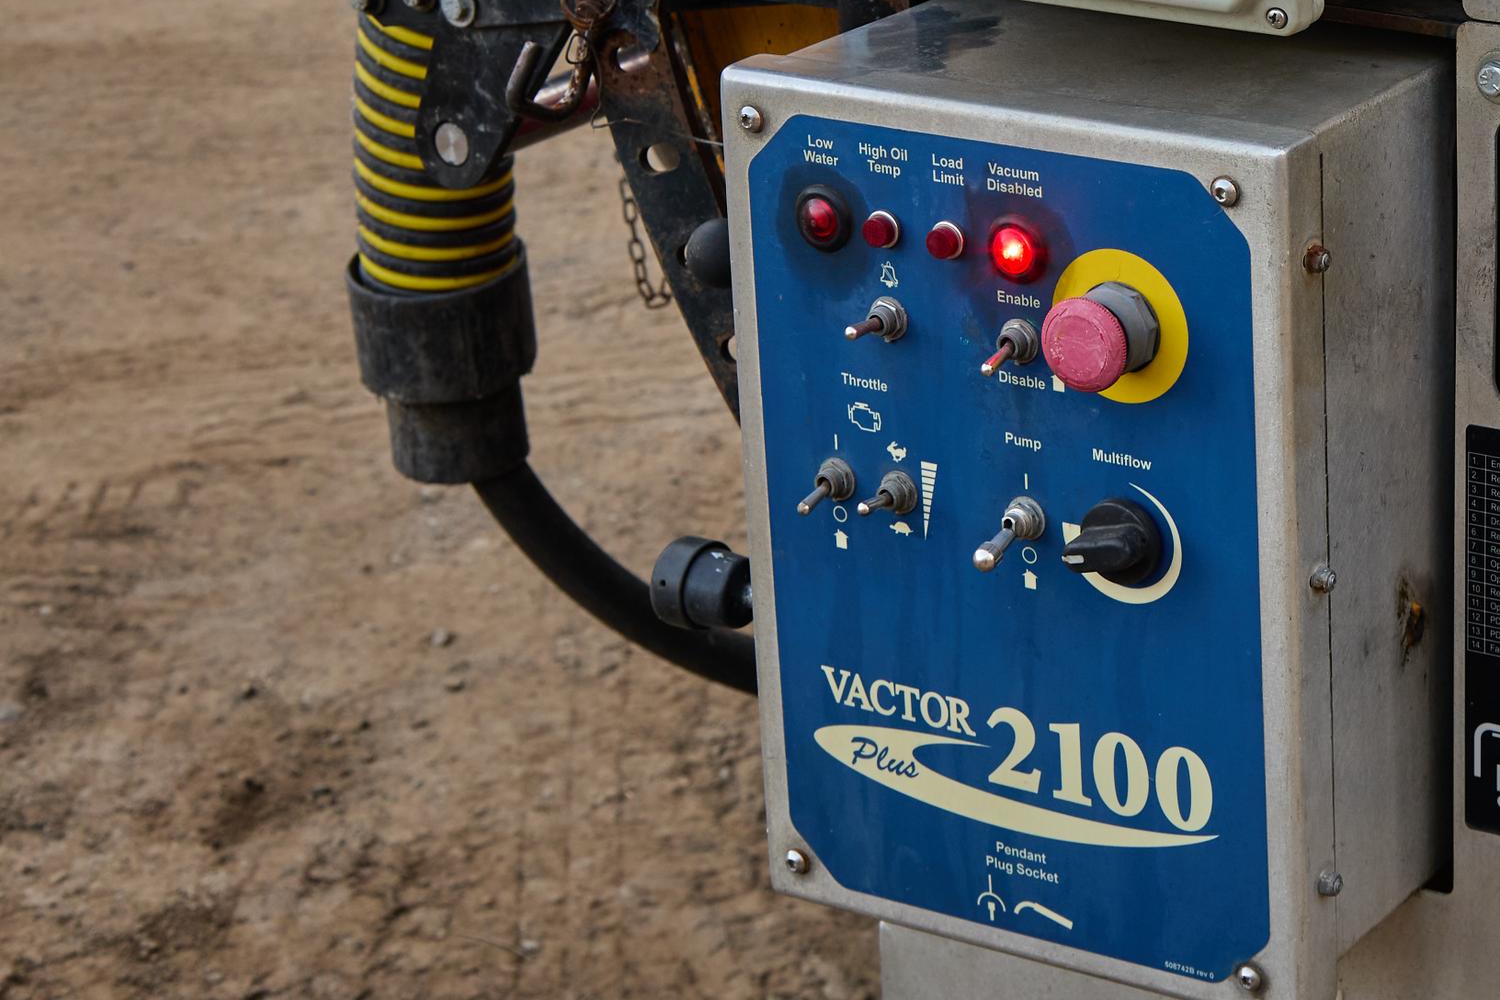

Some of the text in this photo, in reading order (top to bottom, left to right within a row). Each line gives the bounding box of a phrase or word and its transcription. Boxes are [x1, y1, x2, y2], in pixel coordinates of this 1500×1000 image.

[808, 134, 833, 149] Low
[803, 149, 838, 166] Water
[859, 142, 908, 162] High Oil
[932, 153, 963, 170] Load
[867, 159, 901, 178] Temp
[933, 169, 964, 186] Limit
[988, 162, 1039, 182] Vacuum
[987, 178, 1042, 198] Disabled
[997, 290, 1040, 308] Enable
[841, 372, 888, 392] Throttle
[999, 370, 1045, 390] Disable
[1005, 432, 1041, 452] Pump
[1092, 448, 1152, 470] Multiflow
[821, 665, 1213, 832] VACTOR 2100
[851, 736, 919, 778] Plus
[996, 841, 1046, 864] Pendant
[986, 855, 1059, 884] Plug Socket
